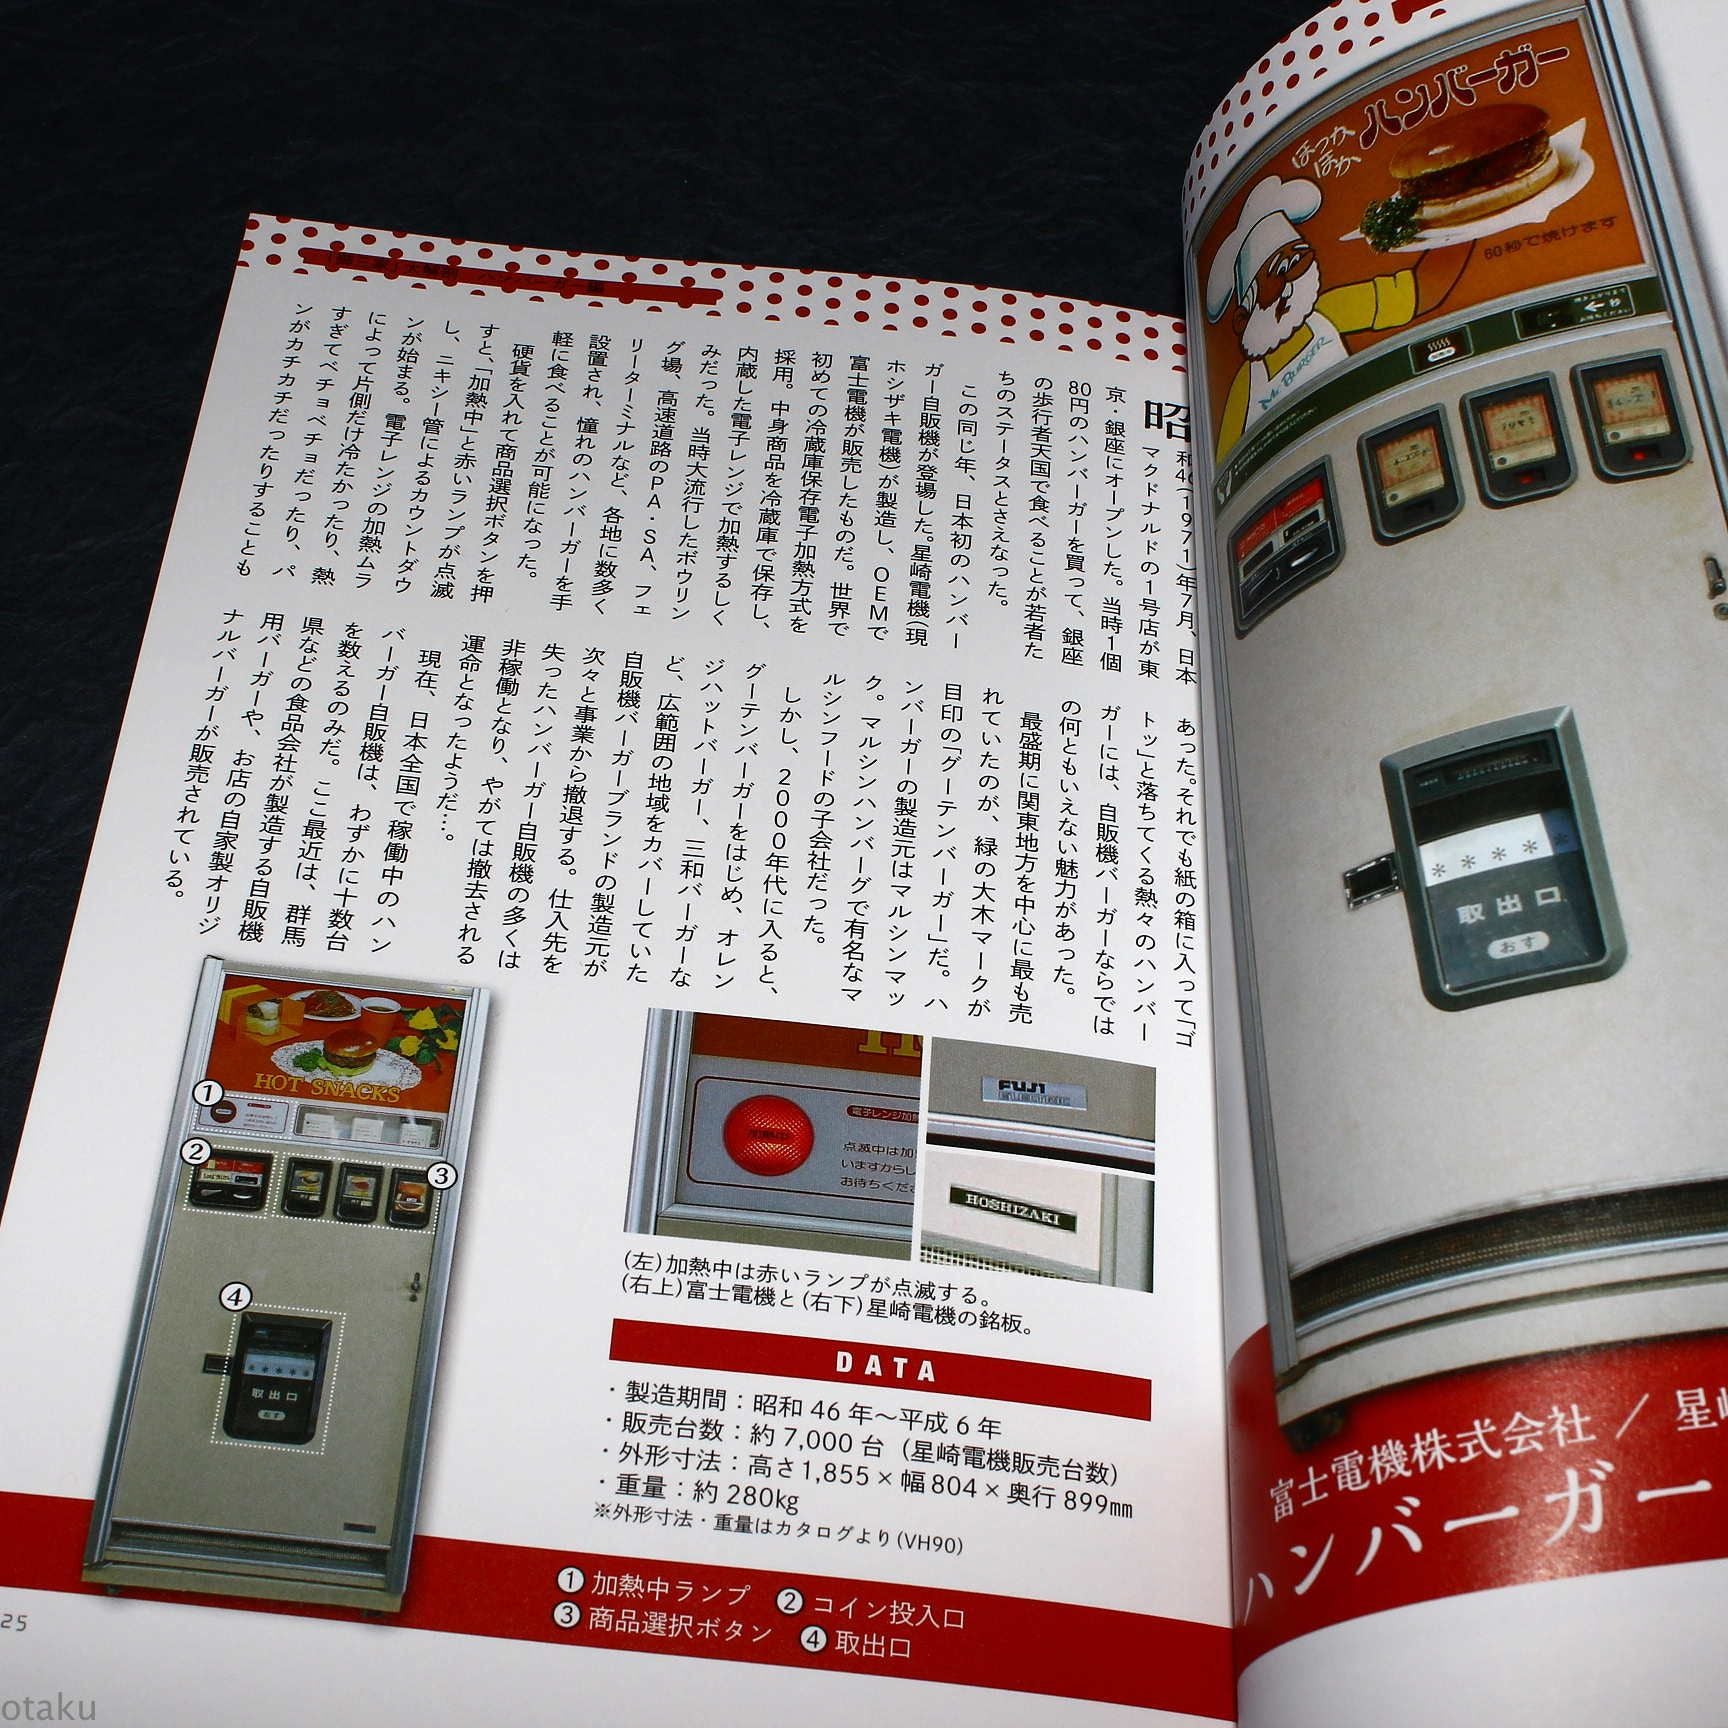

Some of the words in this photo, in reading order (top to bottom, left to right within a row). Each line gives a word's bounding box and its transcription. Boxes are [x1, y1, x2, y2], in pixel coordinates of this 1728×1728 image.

[1360, 43, 1569, 149] ハンバーガー
[236, 303, 313, 577] ンがカチカチだったりすることも
[271, 306, 353, 577] すぎてベチョベチョだったり、パ
[310, 311, 387, 587] によって片側だけ冷たかったり、熱
[355, 317, 425, 589] ンが始まる。電子レンジの加熱ムラ
[395, 320, 460, 594] し、ニキシー管によるカウントダウ
[469, 343, 536, 604] 硬貨を入れて商品選択ボタンを押
[516, 330, 574, 578] 軽に食べることが可能になった。
[549, 333, 612, 612] 設置され、憧れのハンバーガーを手
[591, 338, 643, 615] リーターミナルなど、各地に数多く
[671, 344, 722, 620] みだった。当時大流行したボウリン
[712, 345, 759, 627] 内蔵した電子レンジで加熱するしく
[750, 348, 797, 629] 採用。中身商品を冷蔵庫で保存し、
[788, 351, 833, 634] 初めての冷蔵庫保存電子加熱方式を
[827, 354, 871, 637] 富士電機が販売したものだ。世界で
[867, 359, 907, 641] ホシザキ電機)が製造し、OEMで
[945, 384, 978, 649] この同じ年、日本初のハンバー
[987, 370, 1016, 607] ちのステータスとさえなった。
[1023, 377, 1054, 660] の歩行者天国で食べることが若者た
[1061, 380, 1092, 667] 80円のハンバーガーを買って、銀座
[1144, 400, 1191, 442] 昭
[1137, 446, 1162, 680] マクドナルドの1号店が東
[165, 608, 244, 898] ナルバーガーが販売されている。
[199, 612, 285, 935] 用バーガーや、お店の自家製オリジ
[237, 616, 325, 944] 県などの食品会社が製造する自販機
[280, 621, 364, 948] を数えるのみだ。ここ最近は、群馬
[325, 627, 407, 952] バーガー自販機は、わずかに十数台
[371, 649, 442, 953] 現在、日本全国で稼働中のハン
[456, 638, 527, 965] 非稼働となり、やがては撤去される
[498, 642, 566, 969] 失ったハンバーガー自販機の多くは
[541, 647, 606, 975] 次々と事業から撤退する。仕入先を
[583, 650, 645, 978] 自販機バーガーブランドの製造元が
[626, 655, 686, 983] ど、広範囲の地域をカバーしていた
[669, 658, 726, 988] ジハットバーガー、三和バーガーな
[714, 663, 767, 989] グーテンバーガーをはじめ、オレン
[758, 686, 803, 995] しかし、2000年代に入ると、
[803, 673, 846, 944] ルシンフードの子会社だった。
[840, 675, 885, 1002] ク。マルシンハンバーグで有名なマ
[884, 680, 924, 1007] ンバーガーの製造元はマルシンマッ
[967, 687, 1005, 1017] れていたのが、緑の大木マークが
[1008, 711, 1044, 1025] 最盛期に関東地方を中心に最も売
[1053, 700, 1083, 995] の何ともいえない魅力があった。
[1093, 705, 1121, 1035] ガーには、自販機バーガーならでは
[1456, 886, 1561, 925] 取出口
[1500, 935, 1537, 953] おす
[254, 1073, 305, 1092] HOT
[311, 1079, 400, 1102] SNACKS
[843, 1141, 917, 1158] 点滅中は加
[965, 1193, 1061, 1226] HOSHIZAKI
[836, 1351, 937, 1382] DATA
[1270, 1403, 1597, 1522] 富士電機株式会社
[1, 1614, 28, 1631] 25
[589, 1606, 771, 1642] 商品選択ボタン
[835, 1630, 910, 1658] 取出口
[591, 1570, 750, 1606] 加熱中ランプ
[814, 1598, 964, 1629] コイン投入口
[1243, 1460, 1712, 1625] ハンバーガー
